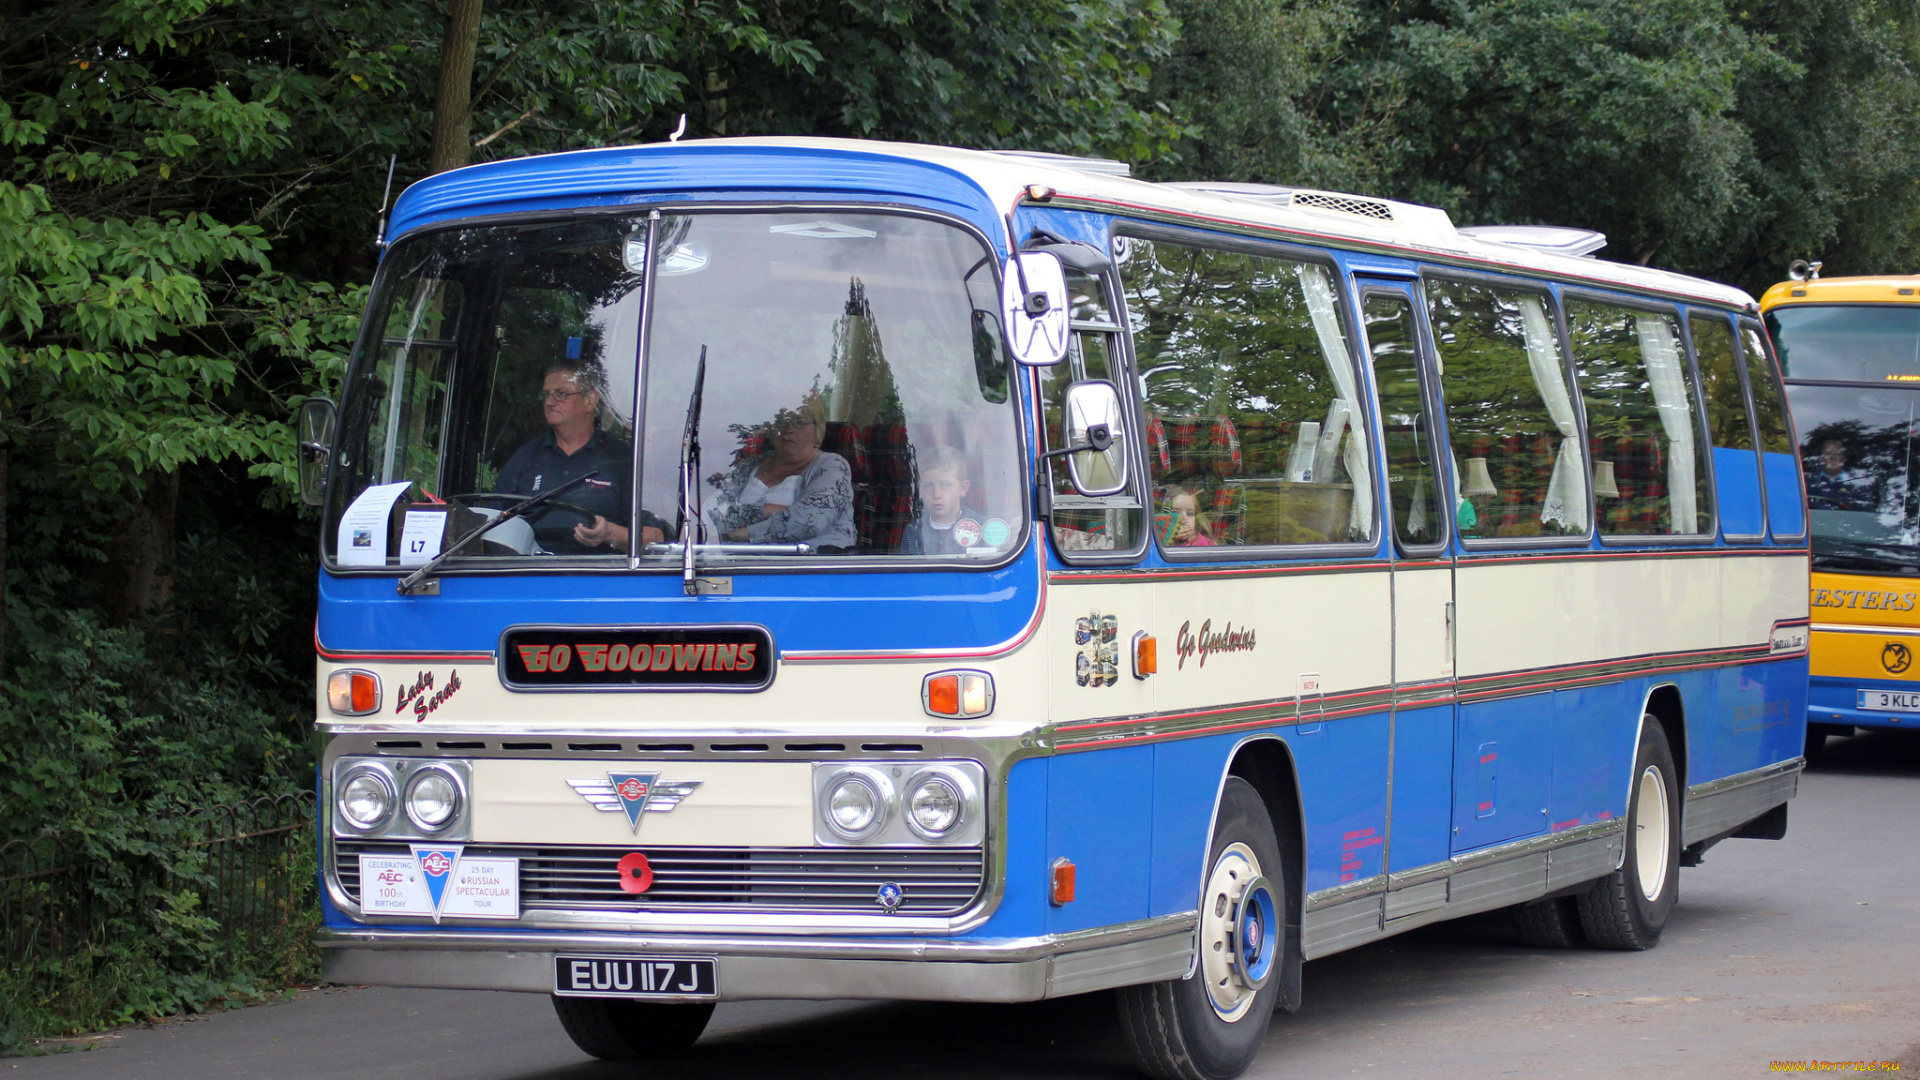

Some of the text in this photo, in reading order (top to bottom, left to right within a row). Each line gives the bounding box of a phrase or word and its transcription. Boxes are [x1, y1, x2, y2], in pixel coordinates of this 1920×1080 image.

[411, 540, 426, 553] L7
[1810, 588, 1916, 612] ESTERS
[1177, 618, 1257, 672] Go Goodwins
[517, 643, 757, 673] GO GOODWINS
[395, 669, 434, 715] Lady
[414, 668, 462, 723] Sarah
[1880, 694, 1919, 708] 3 KLC
[620, 783, 646, 794] AEC
[368, 861, 412, 869] CELEBRATING
[424, 858, 449, 869] AEC
[471, 866, 495, 874] 25 DAY
[377, 870, 403, 884] AEC
[467, 876, 500, 885] RUSSIAN
[456, 887, 510, 896] SPECTACULAR
[375, 900, 407, 908] BIRTHDAY
[474, 900, 492, 908] TOUR
[571, 961, 698, 991] EUU 117J
